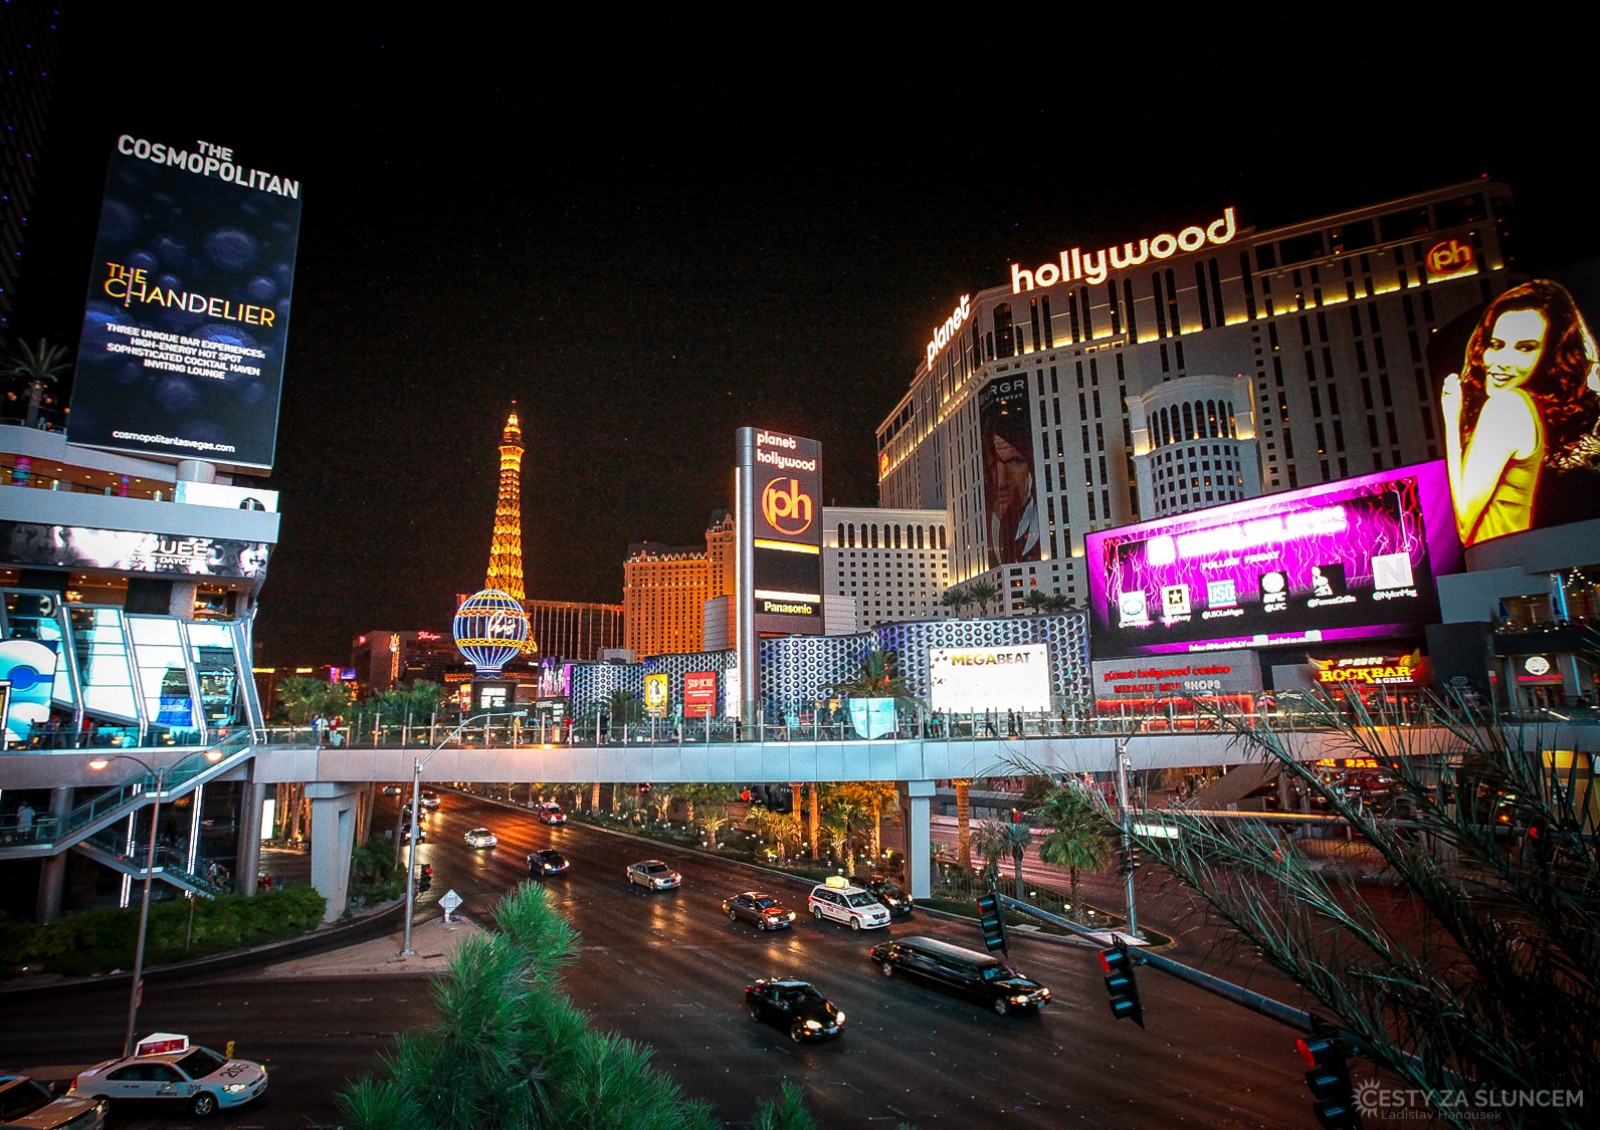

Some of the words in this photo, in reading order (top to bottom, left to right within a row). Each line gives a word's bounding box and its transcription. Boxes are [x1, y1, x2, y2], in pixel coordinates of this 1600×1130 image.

[197, 140, 233, 162] THE
[117, 134, 299, 199] COSMOPOLITAN
[1011, 206, 1236, 294] hollywood
[1432, 239, 1473, 271] ph
[106, 261, 148, 285] THE
[104, 278, 276, 328] CHANDELIER
[106, 323, 140, 337] THREE
[141, 329, 179, 344] UNIQUE
[180, 335, 200, 347] BAR
[927, 293, 970, 371] planet
[106, 343, 183, 363] SOPHISTICATED
[184, 354, 228, 371] COCKTAIL
[229, 365, 260, 377] HAVEN
[130, 337, 197, 356] HIGH-ENERGY
[198, 349, 217, 360] HOT
[218, 352, 243, 364] SPOT
[143, 358, 186, 374] INVITING
[186, 366, 226, 380] LOUNGE
[112, 430, 236, 453] cosmopolitanlasvegas.com
[756, 430, 796, 449] planet
[756, 449, 816, 472] hollywood
[767, 479, 812, 524] ph
[1202, 557, 1240, 571] FOLLOW
[1244, 550, 1280, 564] FRIDAY
[1210, 584, 1236, 603] USO
[764, 601, 812, 615] Panasonic
[951, 652, 1030, 667] MEGABEAT
[1103, 670, 1136, 682] planet
[1137, 666, 1191, 680] hollywood
[1193, 665, 1231, 676] casino
[1383, 676, 1413, 684] GRILL
[1113, 684, 1155, 693] MIRACLE
[1159, 682, 1182, 691] MILE
[1184, 680, 1221, 691] SHOPS
[220, 1064, 249, 1078] 205
